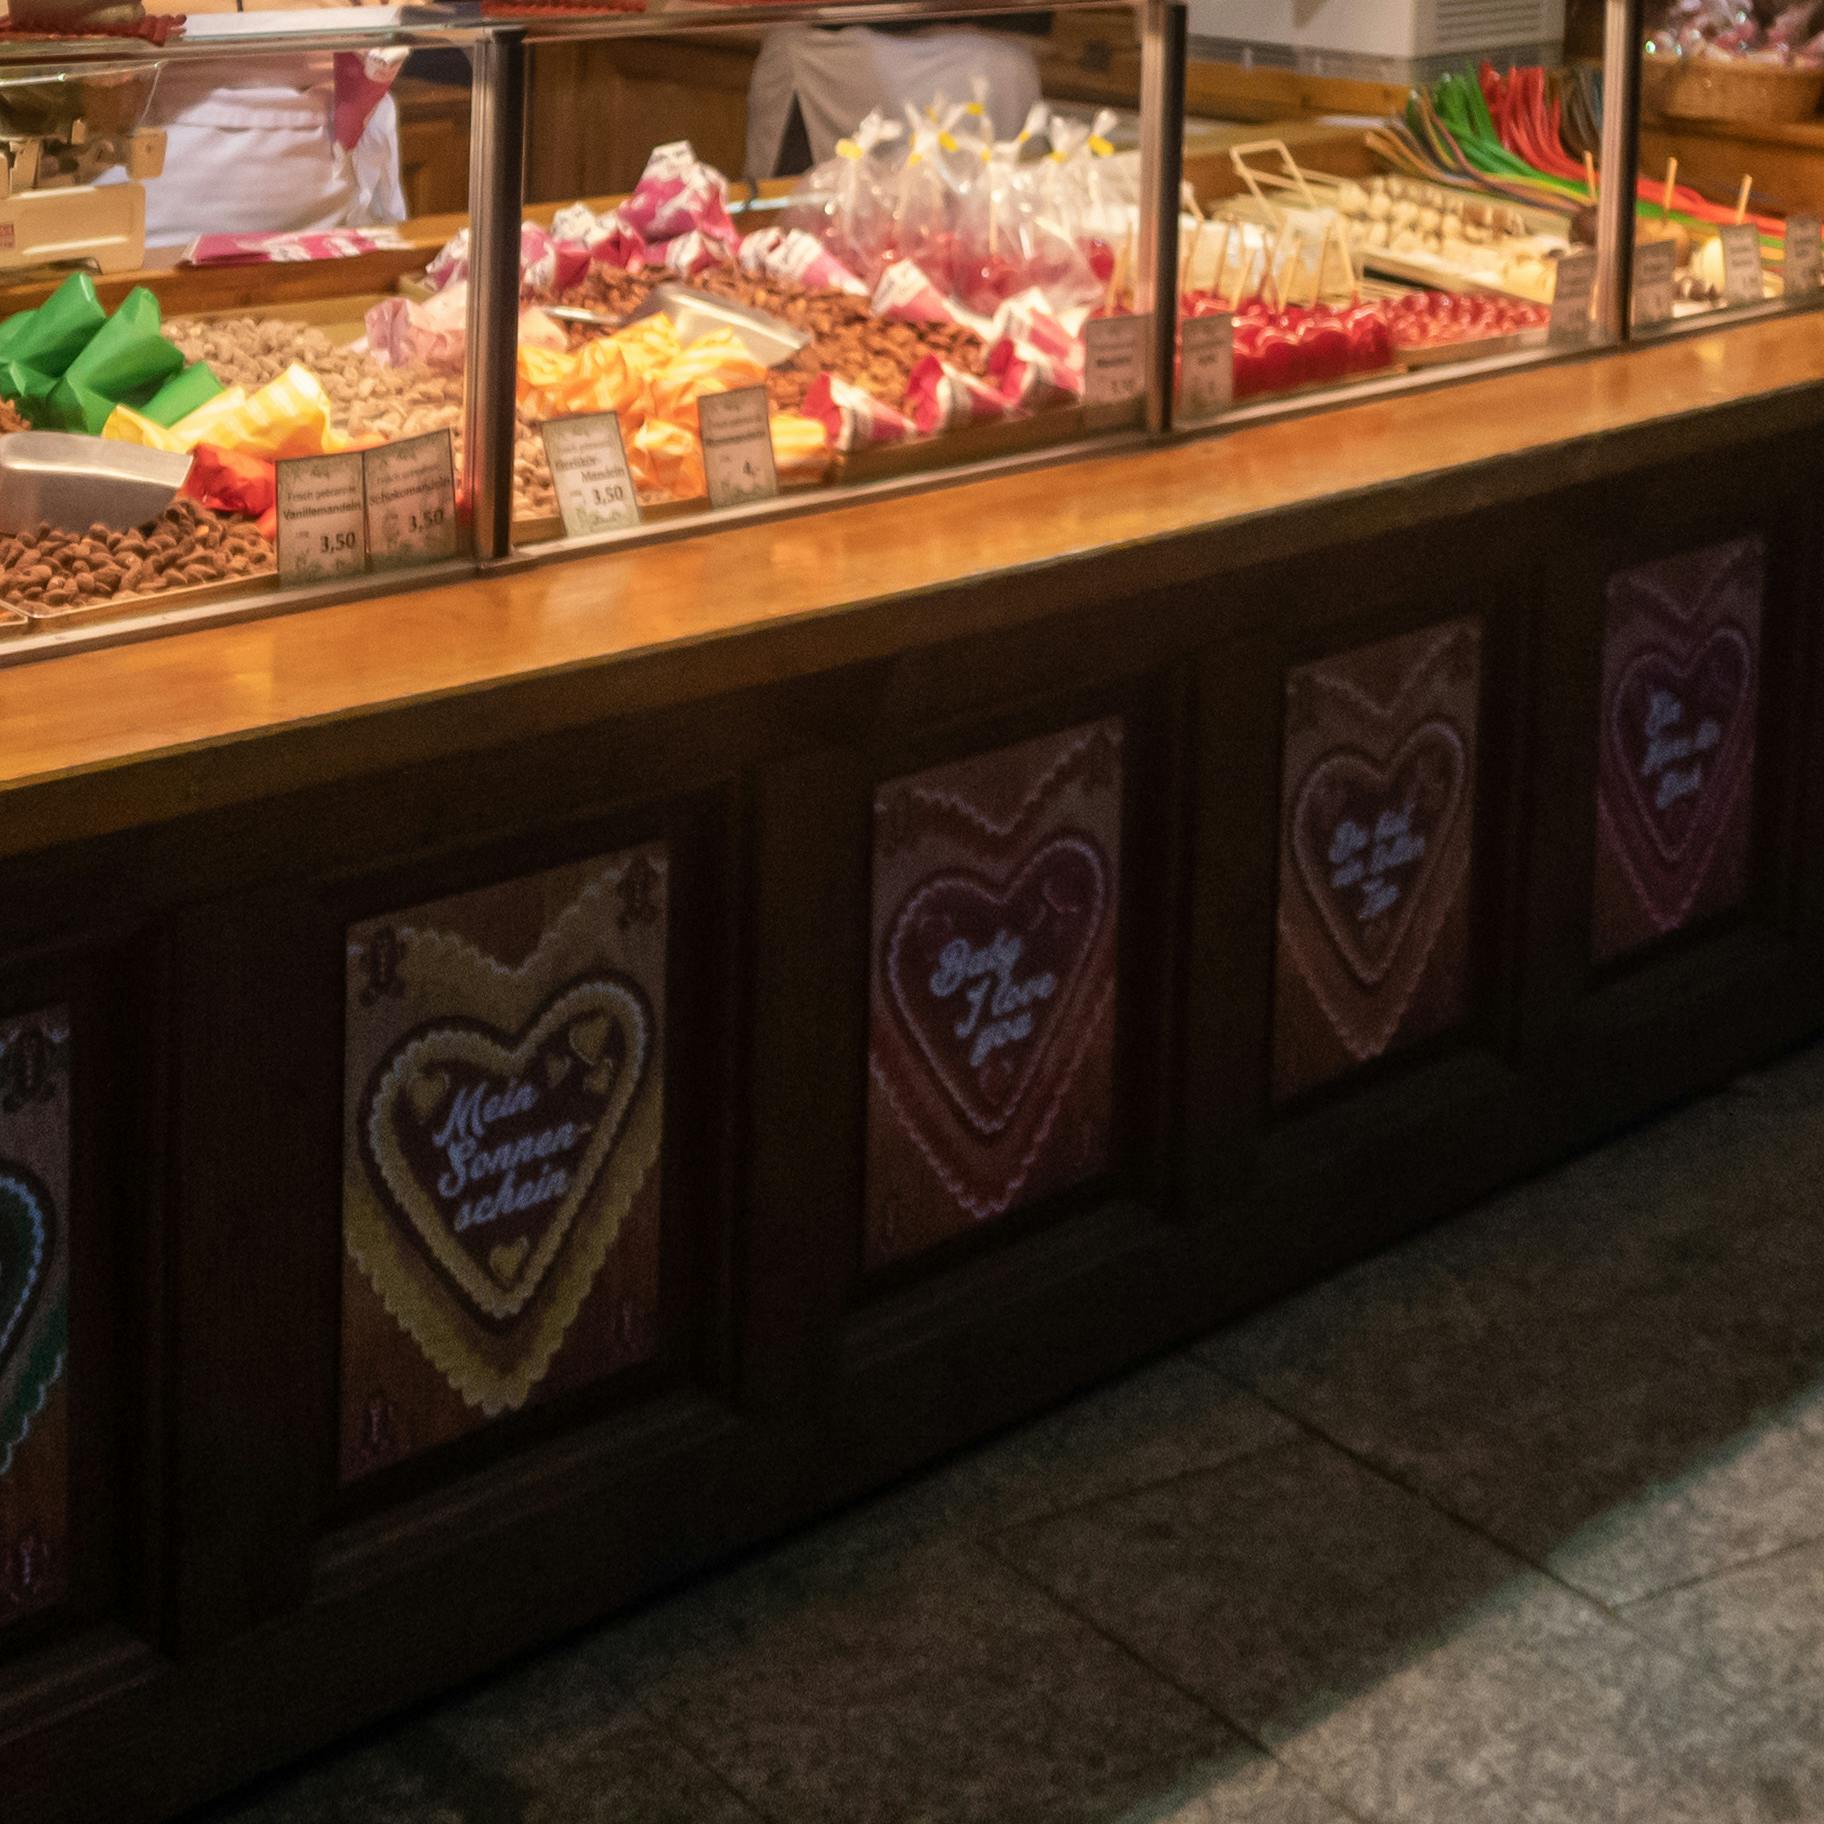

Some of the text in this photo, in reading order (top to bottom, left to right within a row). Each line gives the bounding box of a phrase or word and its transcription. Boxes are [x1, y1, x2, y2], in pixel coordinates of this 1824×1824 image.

[319, 531, 356, 554] 3,50
[432, 1077, 539, 1148] Mein
[437, 1122, 592, 1199] Sonnen-
[453, 1163, 568, 1233] schein
